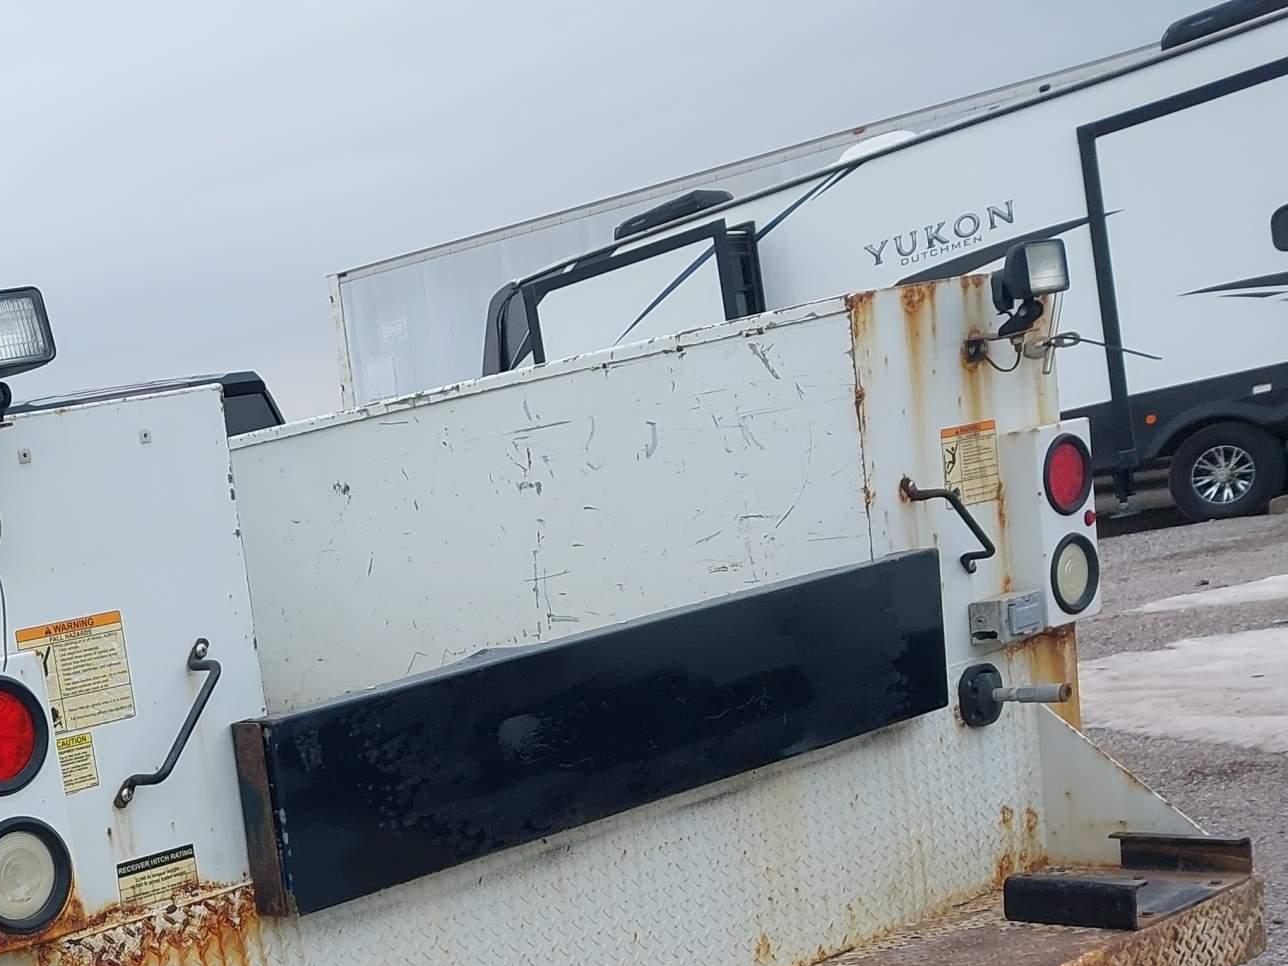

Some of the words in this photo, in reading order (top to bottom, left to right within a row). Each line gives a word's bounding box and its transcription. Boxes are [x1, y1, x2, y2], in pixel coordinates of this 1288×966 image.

[864, 199, 1015, 266] YUKON
[900, 235, 984, 266] DUTCHMEN
[49, 634, 64, 643] FALL
[64, 629, 92, 641] HAZARDS
[52, 617, 95, 634] WARNING
[56, 735, 88, 749] CAUTION
[118, 860, 150, 875] RECEIVER
[150, 855, 170, 867] HITCH
[170, 848, 193, 861] RATING
